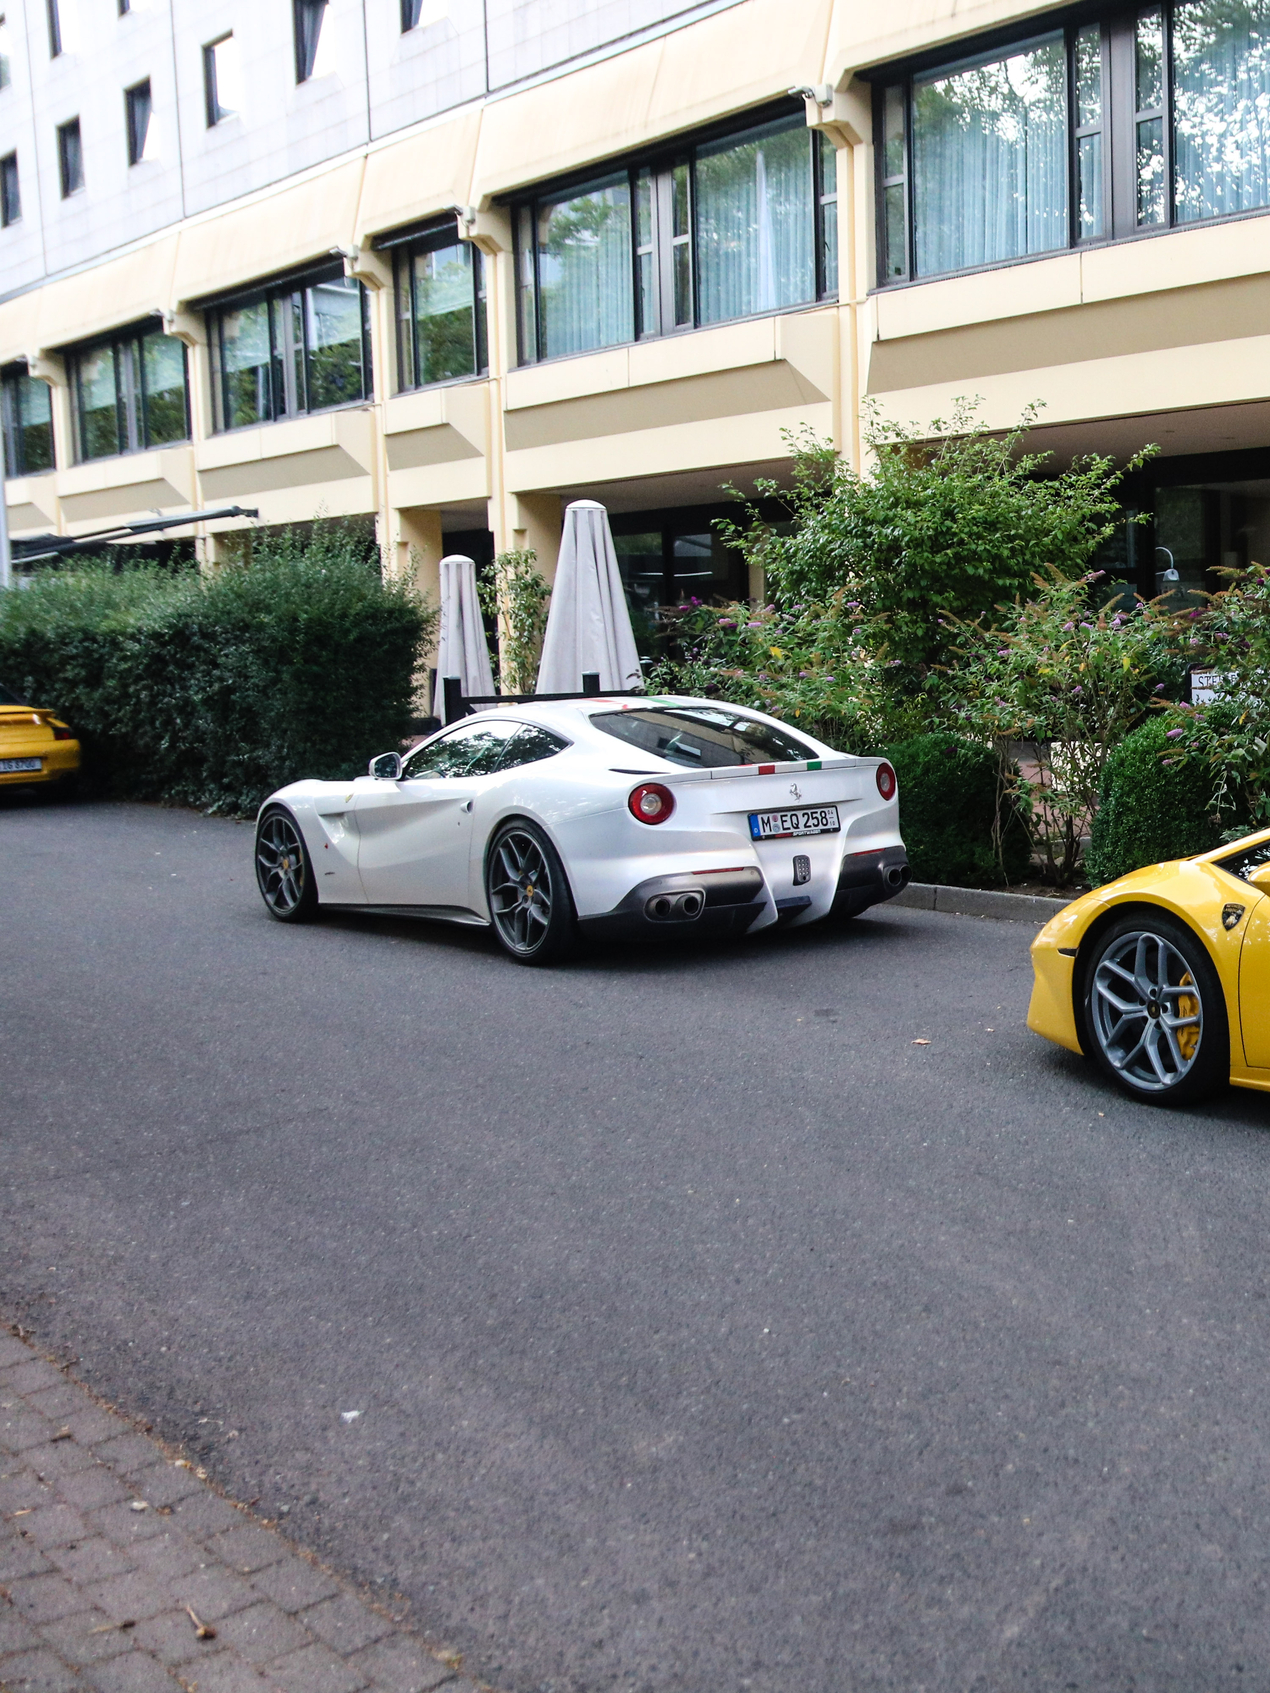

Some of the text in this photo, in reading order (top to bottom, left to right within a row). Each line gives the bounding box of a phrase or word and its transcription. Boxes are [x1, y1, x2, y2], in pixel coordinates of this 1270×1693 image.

[761, 816, 772, 833] M
[780, 813, 800, 831] EQ
[802, 810, 829, 829] 258
